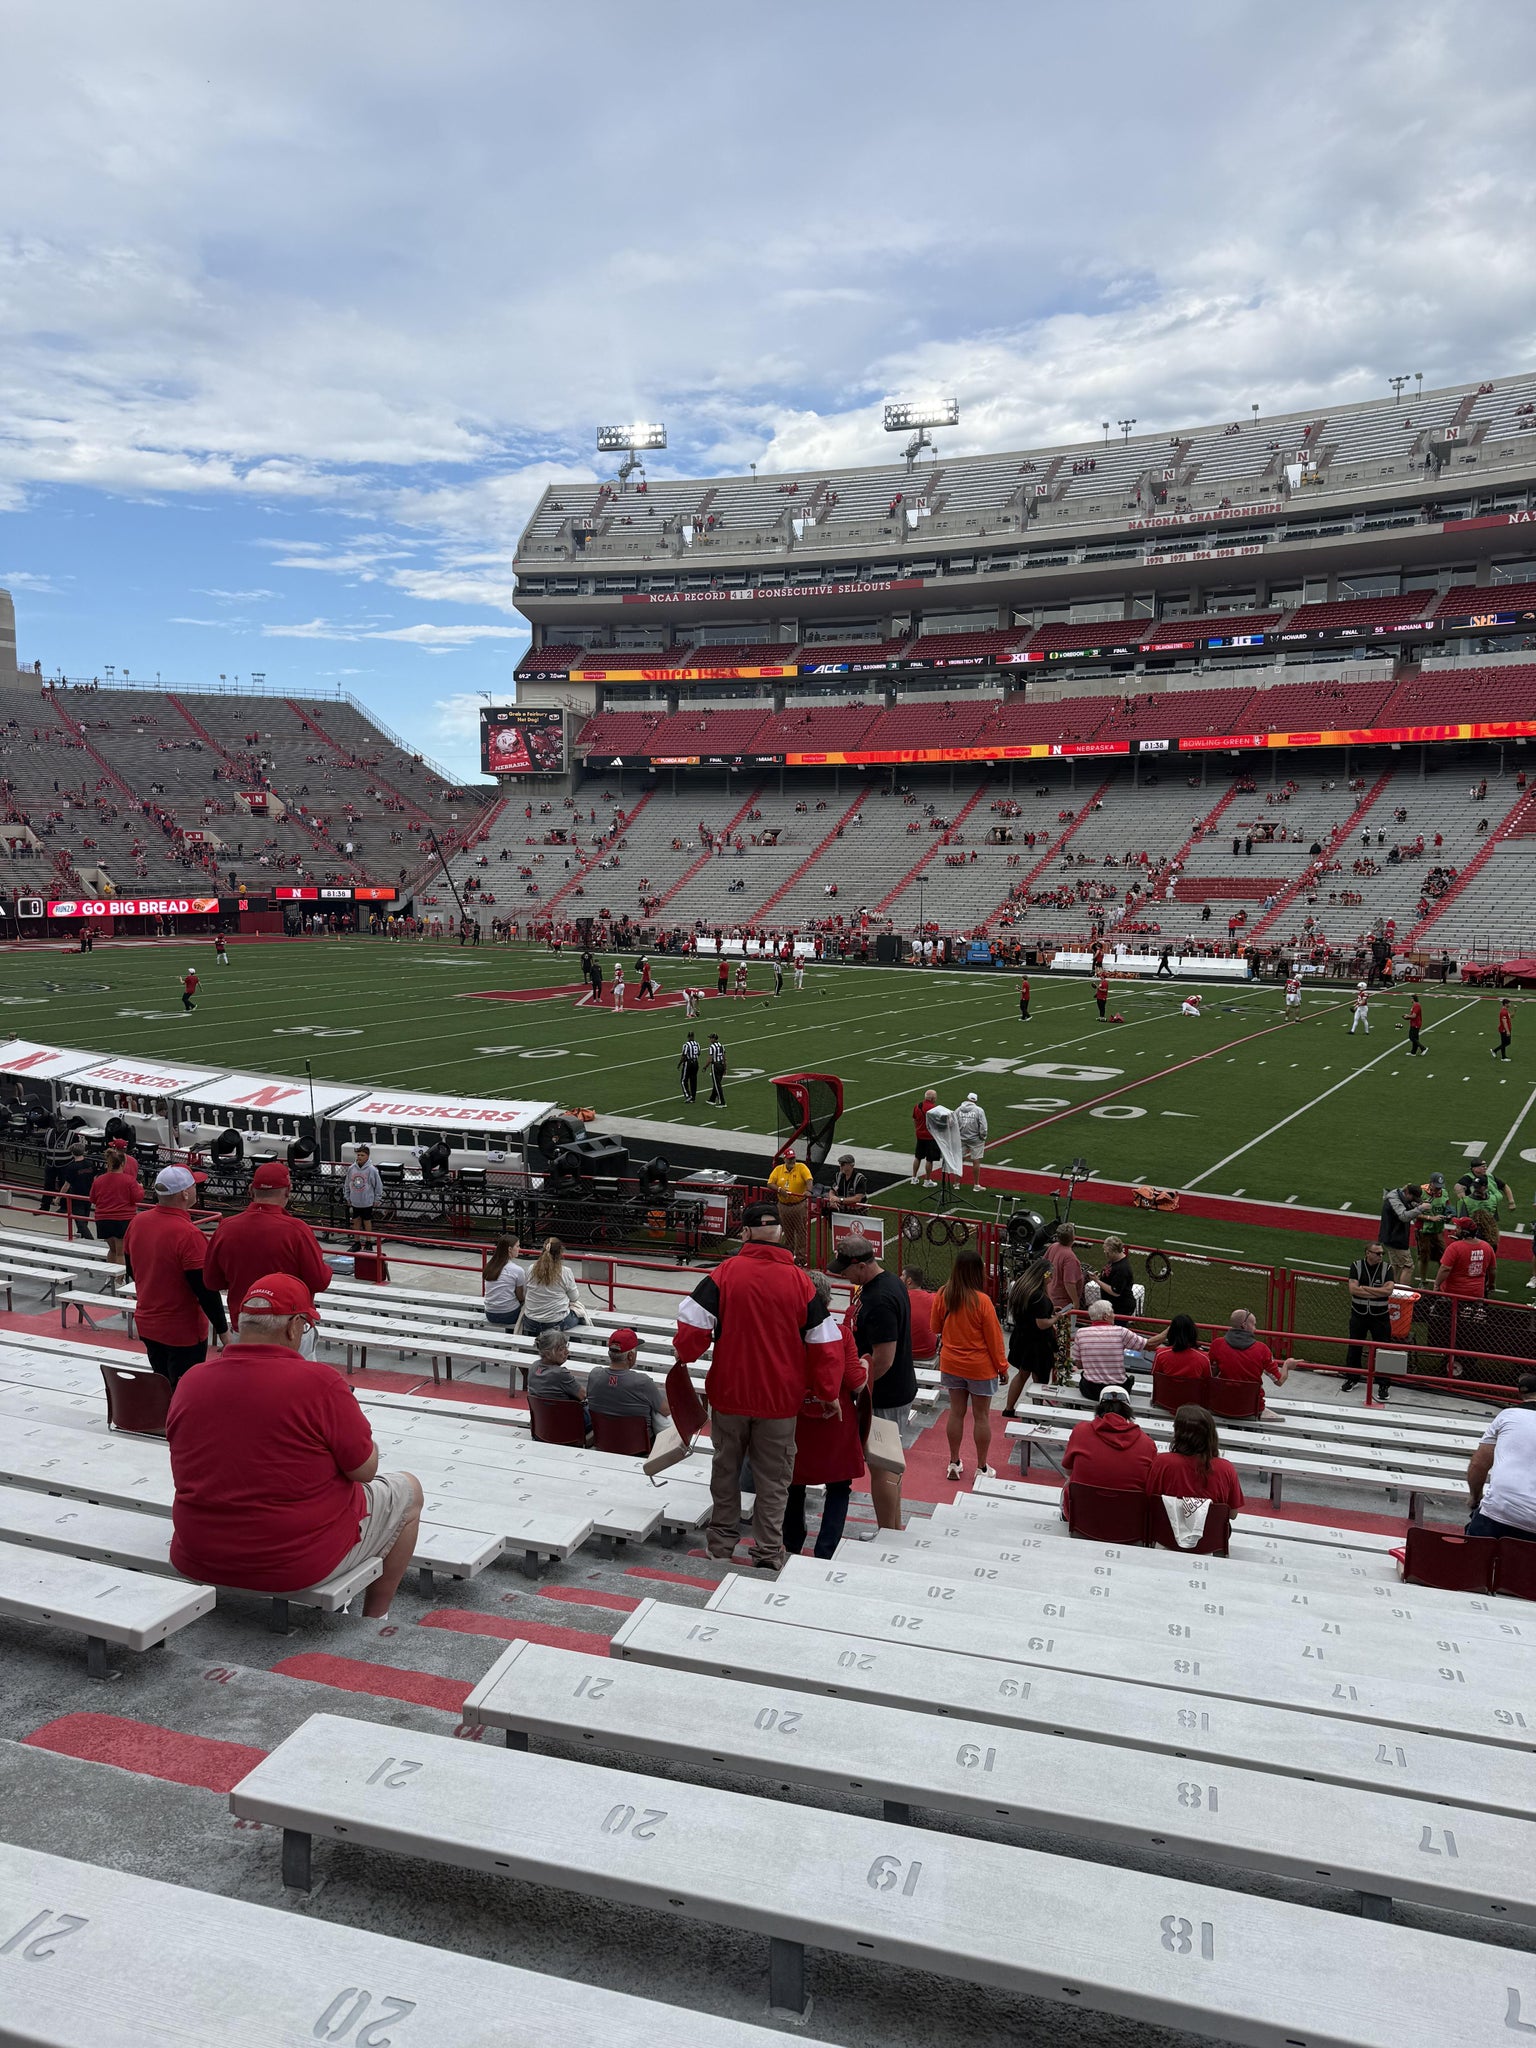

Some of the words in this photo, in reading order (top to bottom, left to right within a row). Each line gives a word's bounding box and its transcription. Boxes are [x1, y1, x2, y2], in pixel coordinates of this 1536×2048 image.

[1446, 427, 1459, 440] N
[1297, 450, 1309, 462] N
[1163, 469, 1175, 481] N
[1037, 486, 1047, 495] N
[916, 498, 927, 507] N
[1128, 516, 1185, 530] NATIONAL
[1189, 504, 1282, 522] CHAMPIONSHIPS
[1146, 556, 1164, 565] 1970
[1170, 554, 1186, 563] 1971
[1192, 551, 1211, 561] 1994
[1240, 546, 1260, 555] 1997
[650, 594, 680, 603] NCAA
[684, 592, 726, 601] RECORD
[758, 586, 833, 598] CONSECUTIVE
[838, 582, 891, 594] SELLOUTS
[1282, 632, 1308, 641] HOWARD
[1398, 624, 1422, 632] INDIANA
[813, 664, 842, 674] ACC
[1052, 744, 1062, 755] N
[1076, 744, 1115, 752] NEBRASKA
[1144, 741, 1165, 750] 81:38
[1182, 738, 1222, 748] BOWLING
[1222, 738, 1250, 746] GREEN
[494, 762, 530, 771] NEBRASKA
[292, 888, 302, 898] N
[326, 890, 346, 898] 81:38
[32, 901, 39, 914] 0
[56, 904, 75, 914] RUNZA
[82, 902, 106, 915] GO
[110, 902, 135, 914] BIG
[139, 900, 190, 914] BREAD
[238, 900, 249, 911] N
[85, 1067, 190, 1089] HUSKERS
[228, 1086, 305, 1107] N
[358, 1102, 522, 1122] HUSKERS
[1005, 1098, 1148, 1120] 20
[608, 1376, 618, 1386] N
[427, 1502, 443, 1512] 2
[944, 1528, 960, 1538] 21
[914, 1539, 932, 1549] 21
[1022, 1538, 1042, 1548] 20
[880, 1552, 900, 1564] 21
[1000, 1552, 1022, 1563] 20
[1104, 1550, 1121, 1559] 19
[825, 1570, 848, 1584] 21
[974, 1568, 999, 1580] 20
[1094, 1566, 1112, 1576] 19
[1189, 1580, 1207, 1590] 18
[1282, 1574, 1298, 1584] 17
[927, 1586, 956, 1600] 20
[1090, 1586, 1111, 1598] 19
[764, 1592, 791, 1607] 21
[1292, 1594, 1309, 1606] 17
[1042, 1603, 1066, 1618] 19
[1204, 1604, 1225, 1616] 18
[1392, 1608, 1413, 1620] 16
[890, 1614, 924, 1631] 20
[1322, 1622, 1342, 1635] 17
[686, 1624, 720, 1642] 21
[1168, 1623, 1191, 1639] 18
[1500, 1624, 1522, 1636] 15
[1028, 1636, 1055, 1652] 19
[1436, 1640, 1461, 1654] 16
[1302, 1646, 1325, 1660] 17
[836, 1650, 877, 1671] 20
[1174, 1659, 1201, 1676] 18
[1438, 1668, 1466, 1683] 16
[572, 1675, 615, 1700] 21
[1000, 1678, 1032, 1700] 19
[1332, 1684, 1358, 1701] 17
[754, 1707, 804, 1735] 20
[1177, 1709, 1210, 1732] 18
[1494, 1708, 1527, 1729] 16
[956, 1744, 997, 1772] 19
[1375, 1744, 1408, 1768] 17
[366, 1757, 424, 1790] 21
[1177, 1782, 1219, 1813] 18
[600, 1804, 668, 1842] 20
[1418, 1825, 1459, 1859] 17
[866, 1854, 923, 1897] 19
[0, 1909, 90, 1963] 21
[1160, 1914, 1214, 1962] 18
[312, 1987, 417, 2048] 20
